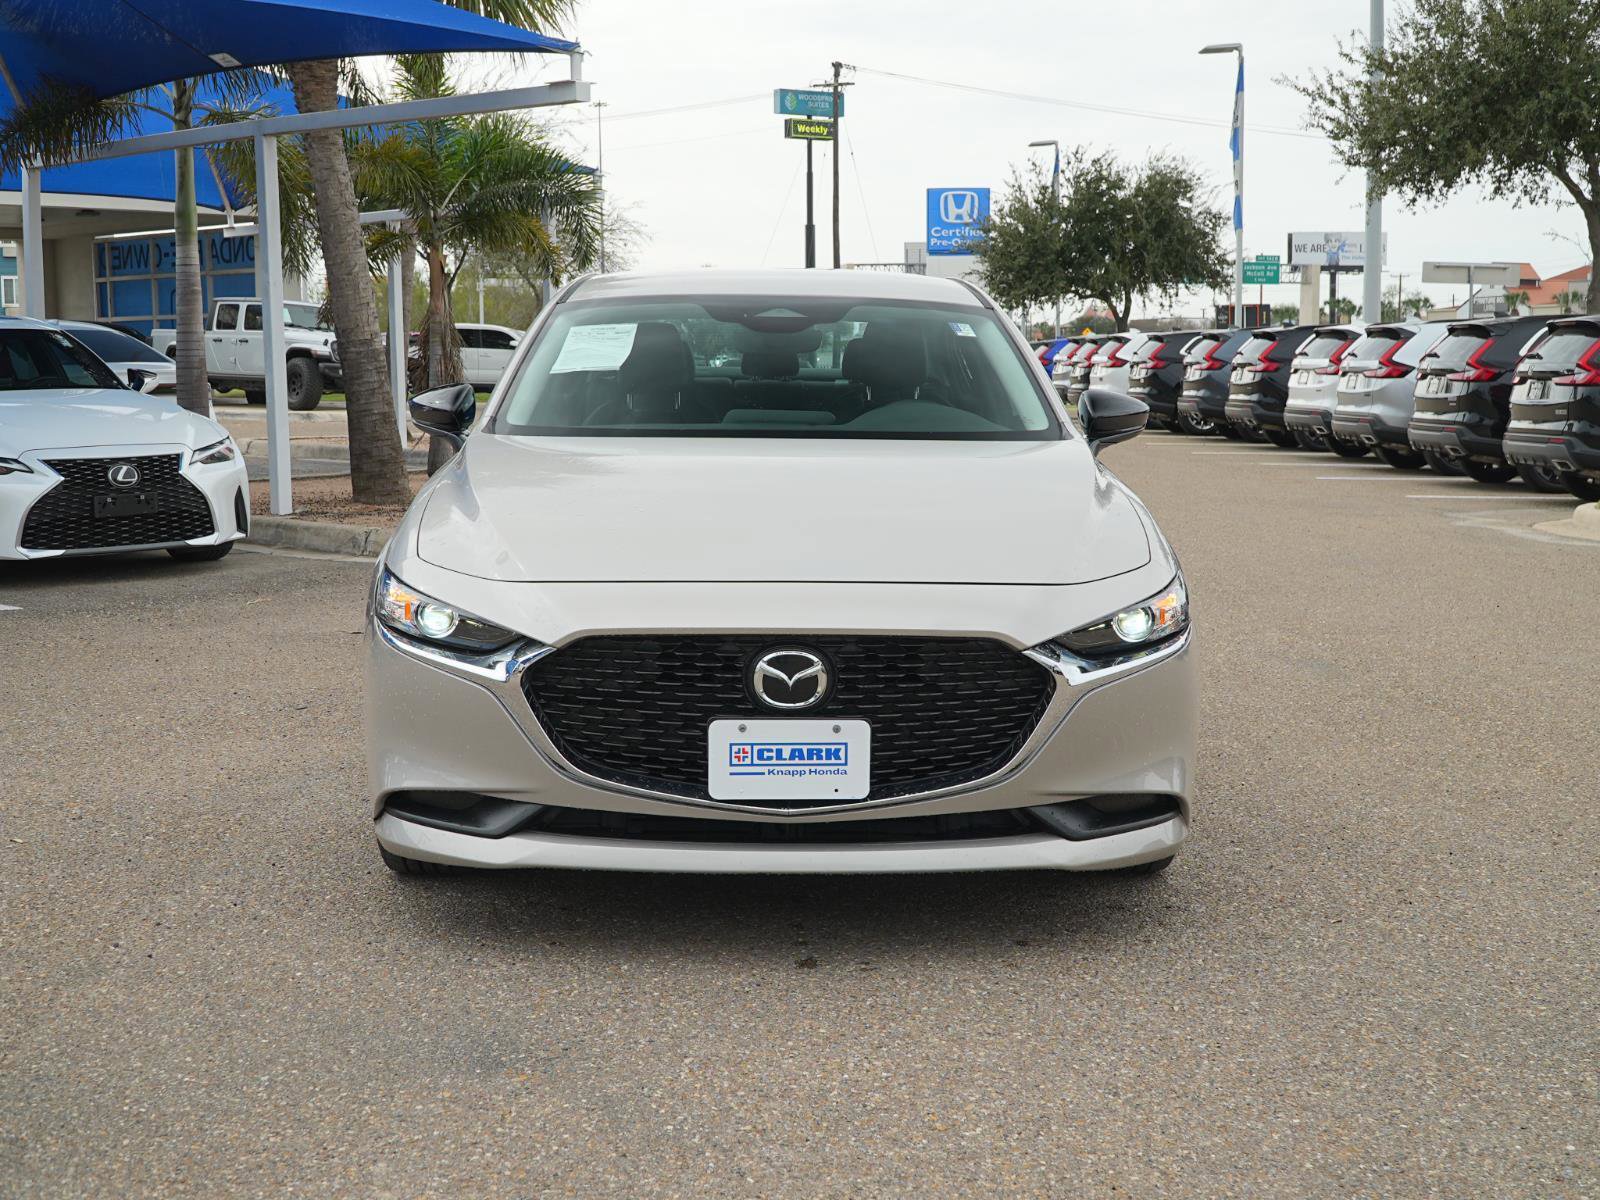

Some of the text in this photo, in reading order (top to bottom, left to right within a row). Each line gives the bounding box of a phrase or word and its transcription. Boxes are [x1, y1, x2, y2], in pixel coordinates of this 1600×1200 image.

[808, 101, 830, 109] SUITES
[797, 124, 828, 135] Weekly
[1294, 243, 1327, 253] WE ARE
[756, 747, 843, 762] CLARK
[767, 768, 848, 778] Knapp Honda
